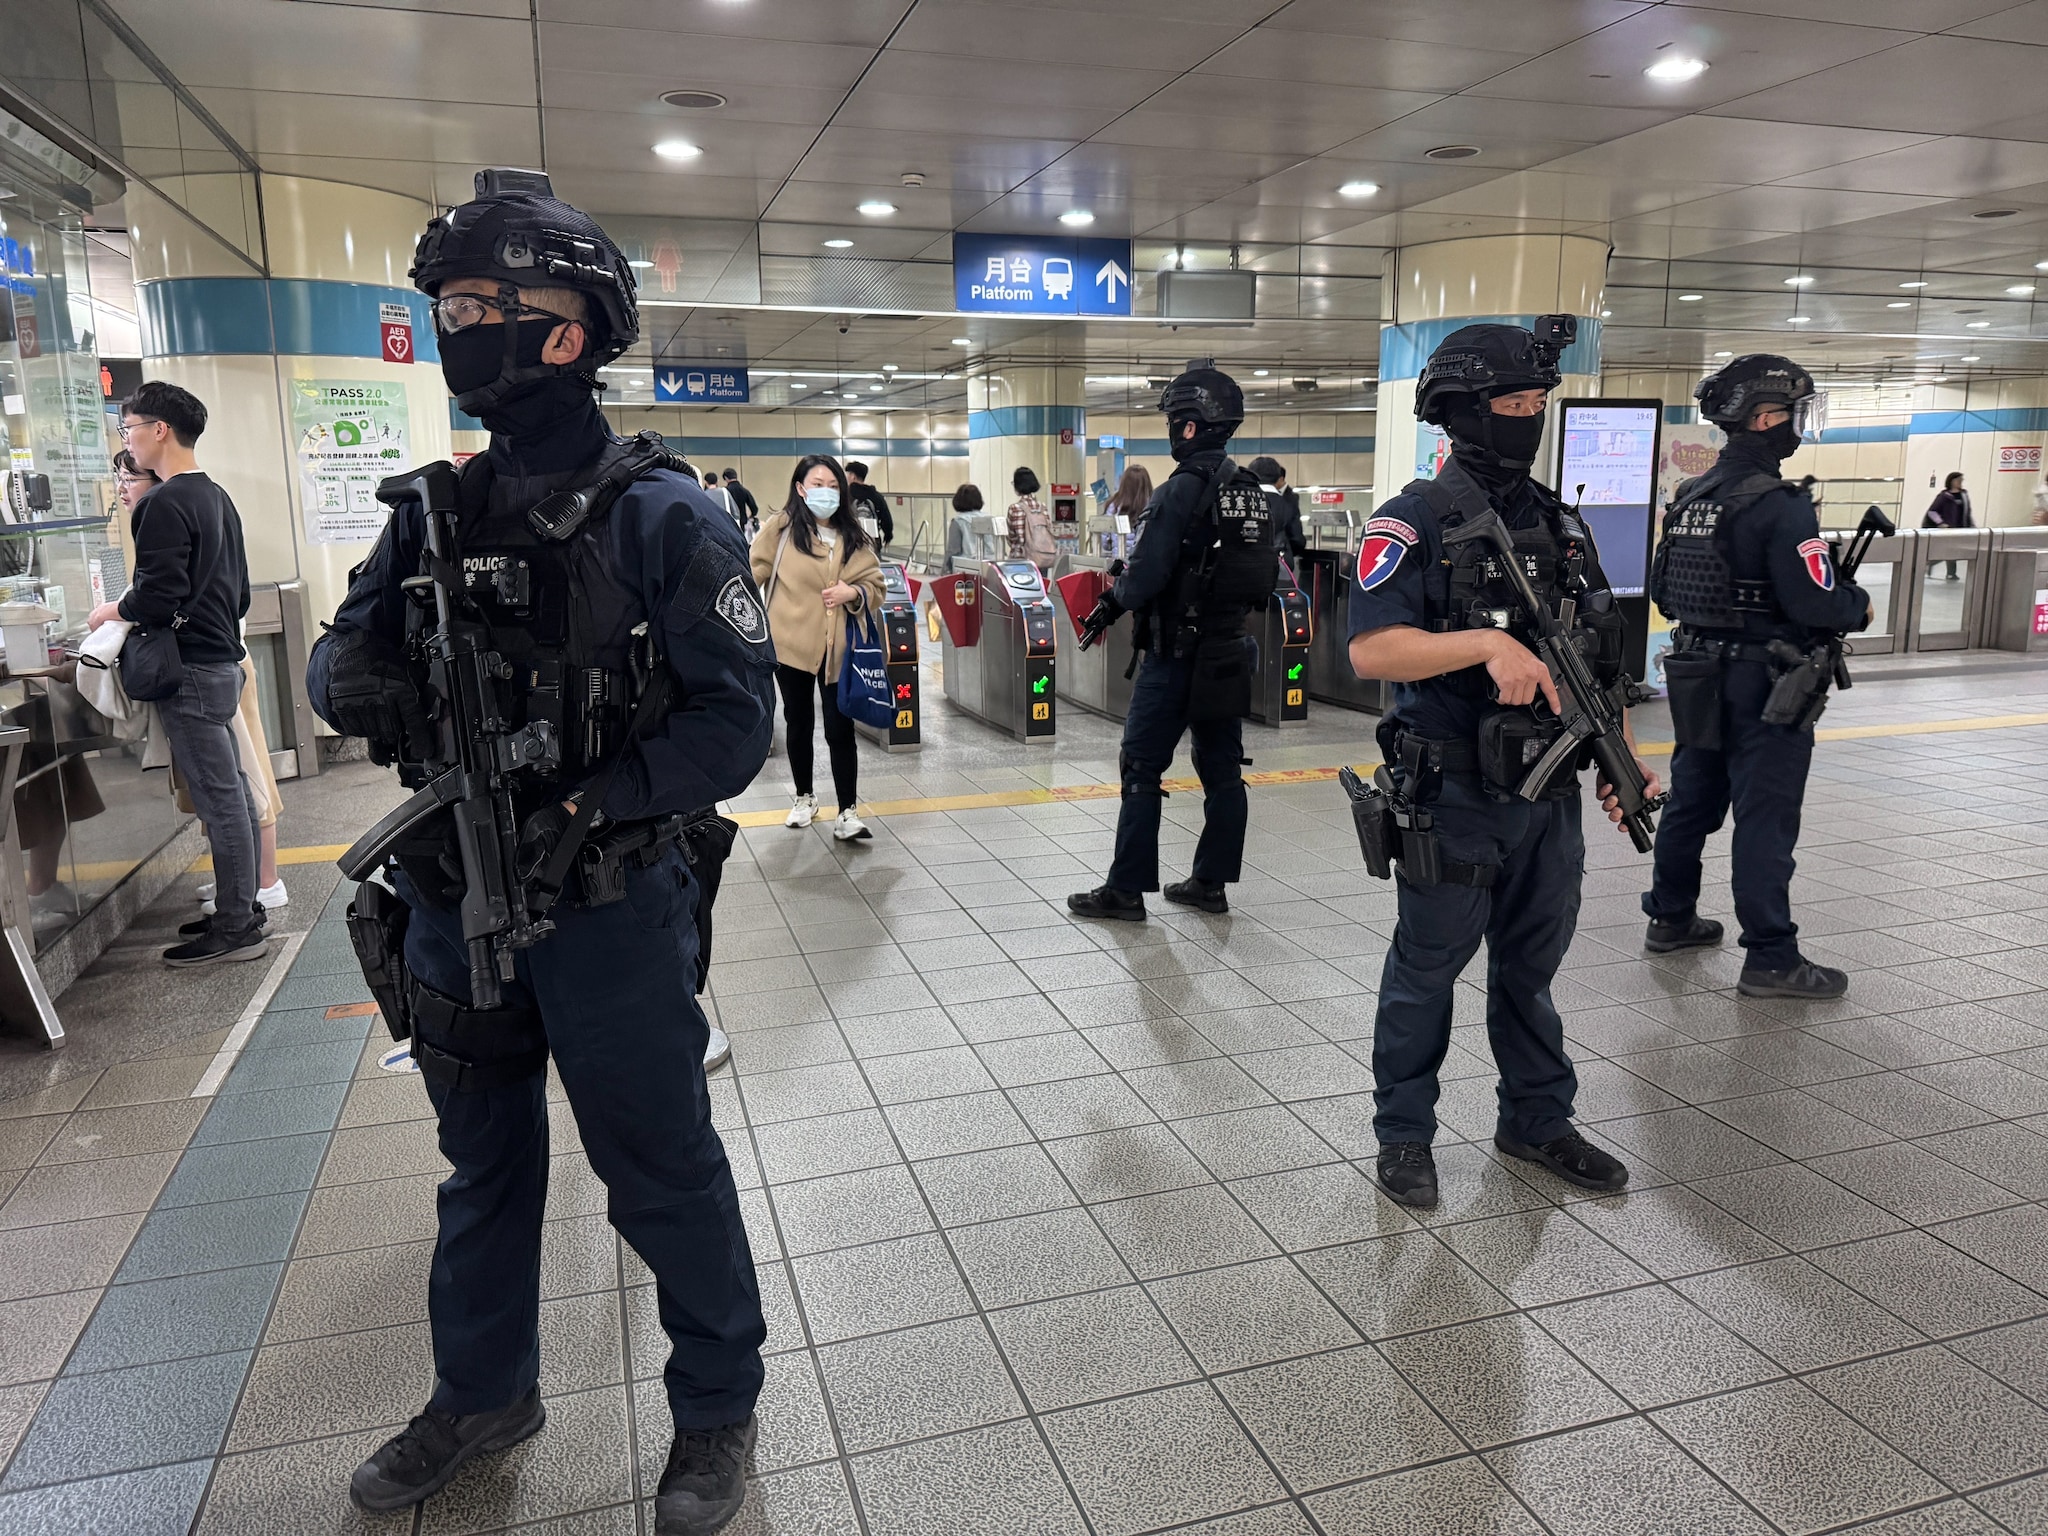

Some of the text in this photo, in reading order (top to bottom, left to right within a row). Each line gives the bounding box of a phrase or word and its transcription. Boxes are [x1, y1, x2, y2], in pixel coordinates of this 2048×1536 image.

[984, 257, 1032, 283] 月台
[971, 284, 1033, 300] Platform
[390, 326, 406, 336] AED
[709, 374, 735, 388] 月台
[321, 387, 382, 398] TPASS 2.0
[709, 388, 743, 397] Platform
